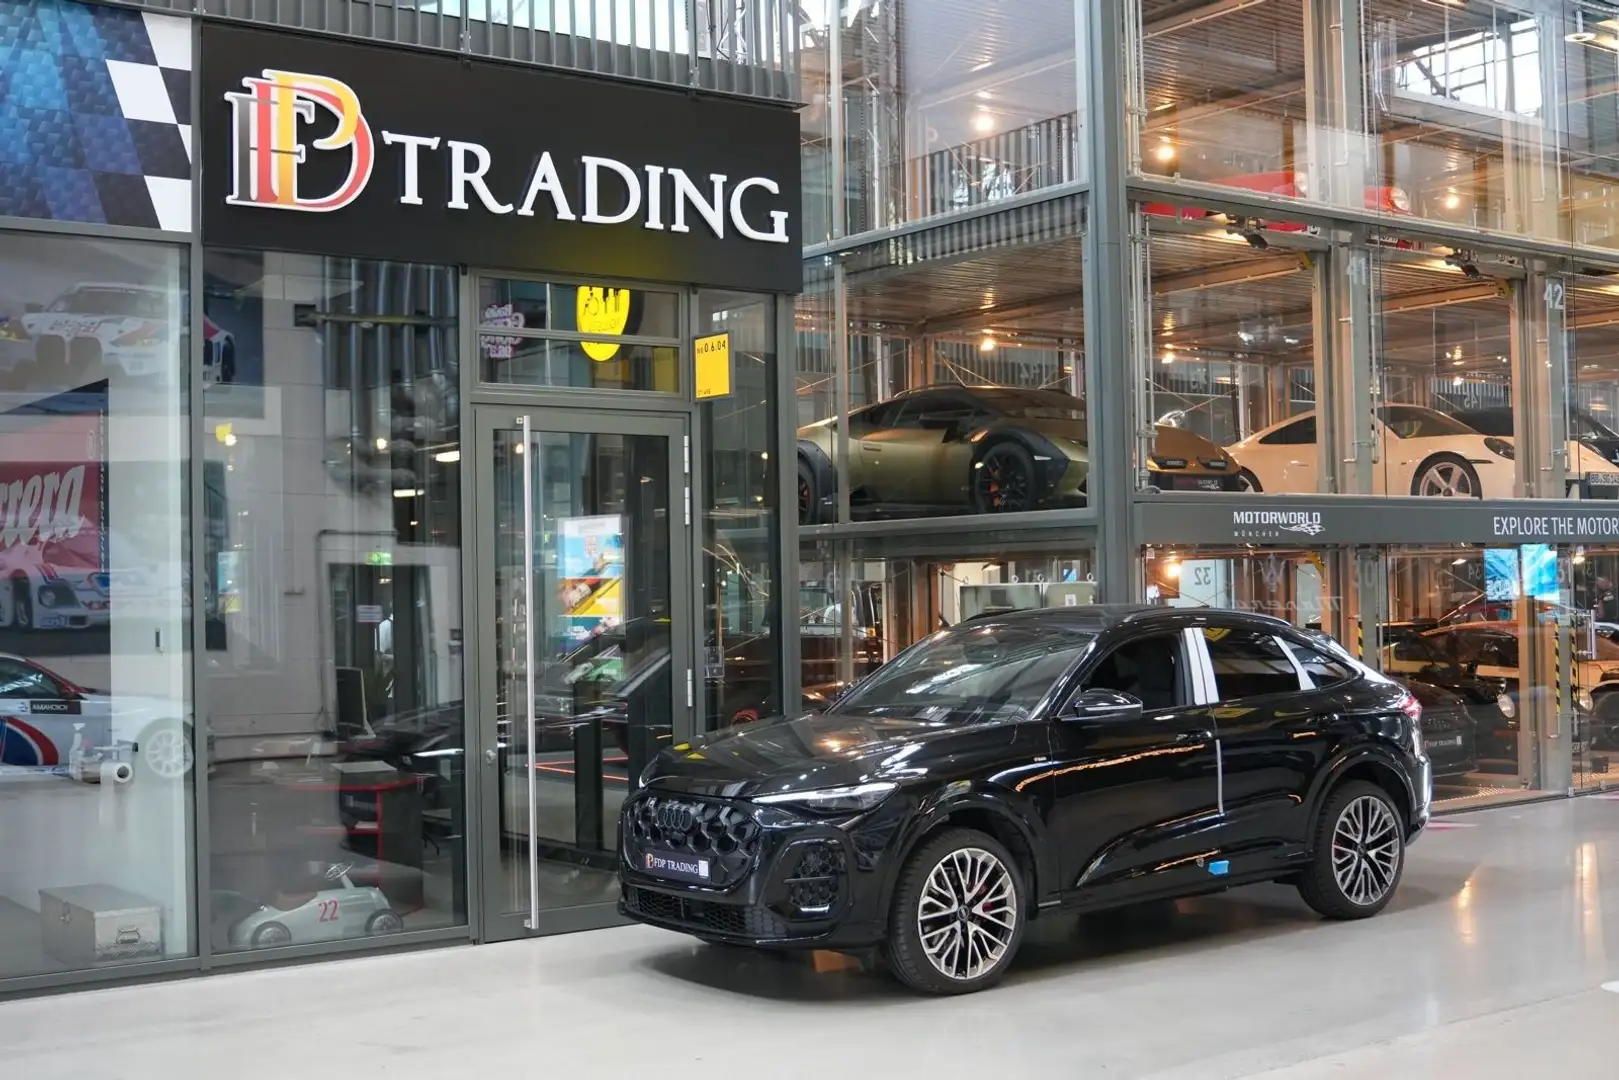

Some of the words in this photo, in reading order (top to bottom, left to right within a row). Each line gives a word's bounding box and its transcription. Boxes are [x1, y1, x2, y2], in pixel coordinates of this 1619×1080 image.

[381, 130, 790, 243] TRADING
[1544, 283, 1564, 310] 42
[1233, 511, 1321, 524] MOTORWORLD
[1493, 516, 1549, 535] EXPLORE
[1551, 517, 1574, 535] THE
[1577, 517, 1619, 535] MOTOR
[653, 857, 666, 868] FDP
[667, 859, 699, 874] TRADING
[318, 899, 339, 922] 22
